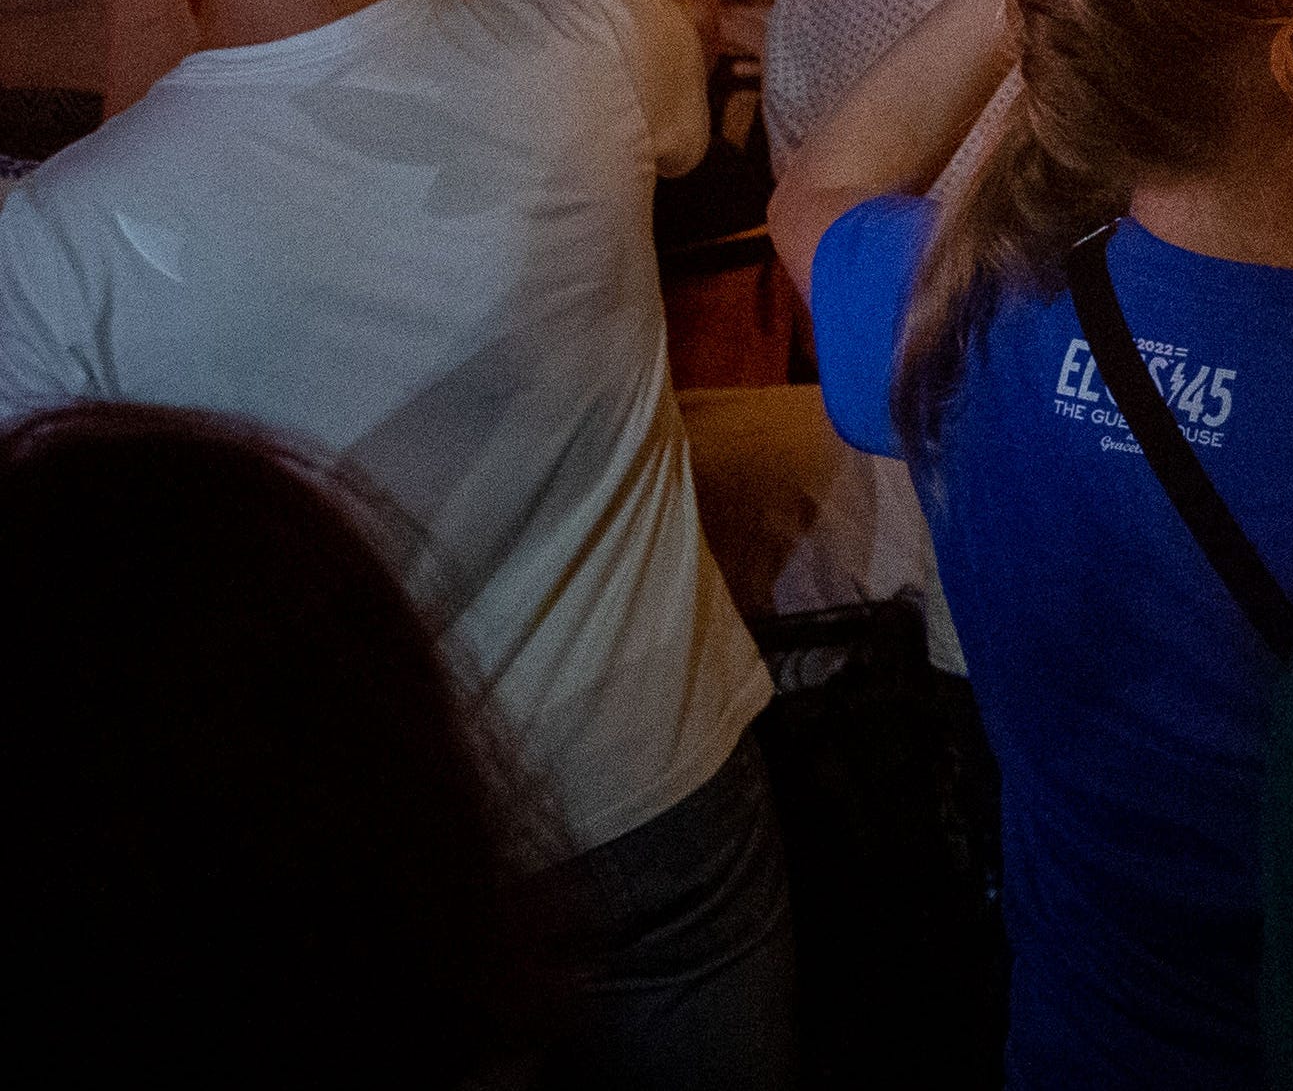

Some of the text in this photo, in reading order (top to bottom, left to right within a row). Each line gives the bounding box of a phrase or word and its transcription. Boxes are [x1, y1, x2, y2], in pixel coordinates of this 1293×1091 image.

[1137, 339, 1174, 355] 2022
[1178, 364, 1238, 428] 45
[1054, 399, 1085, 420] THE
[1091, 408, 1130, 429] GUE
